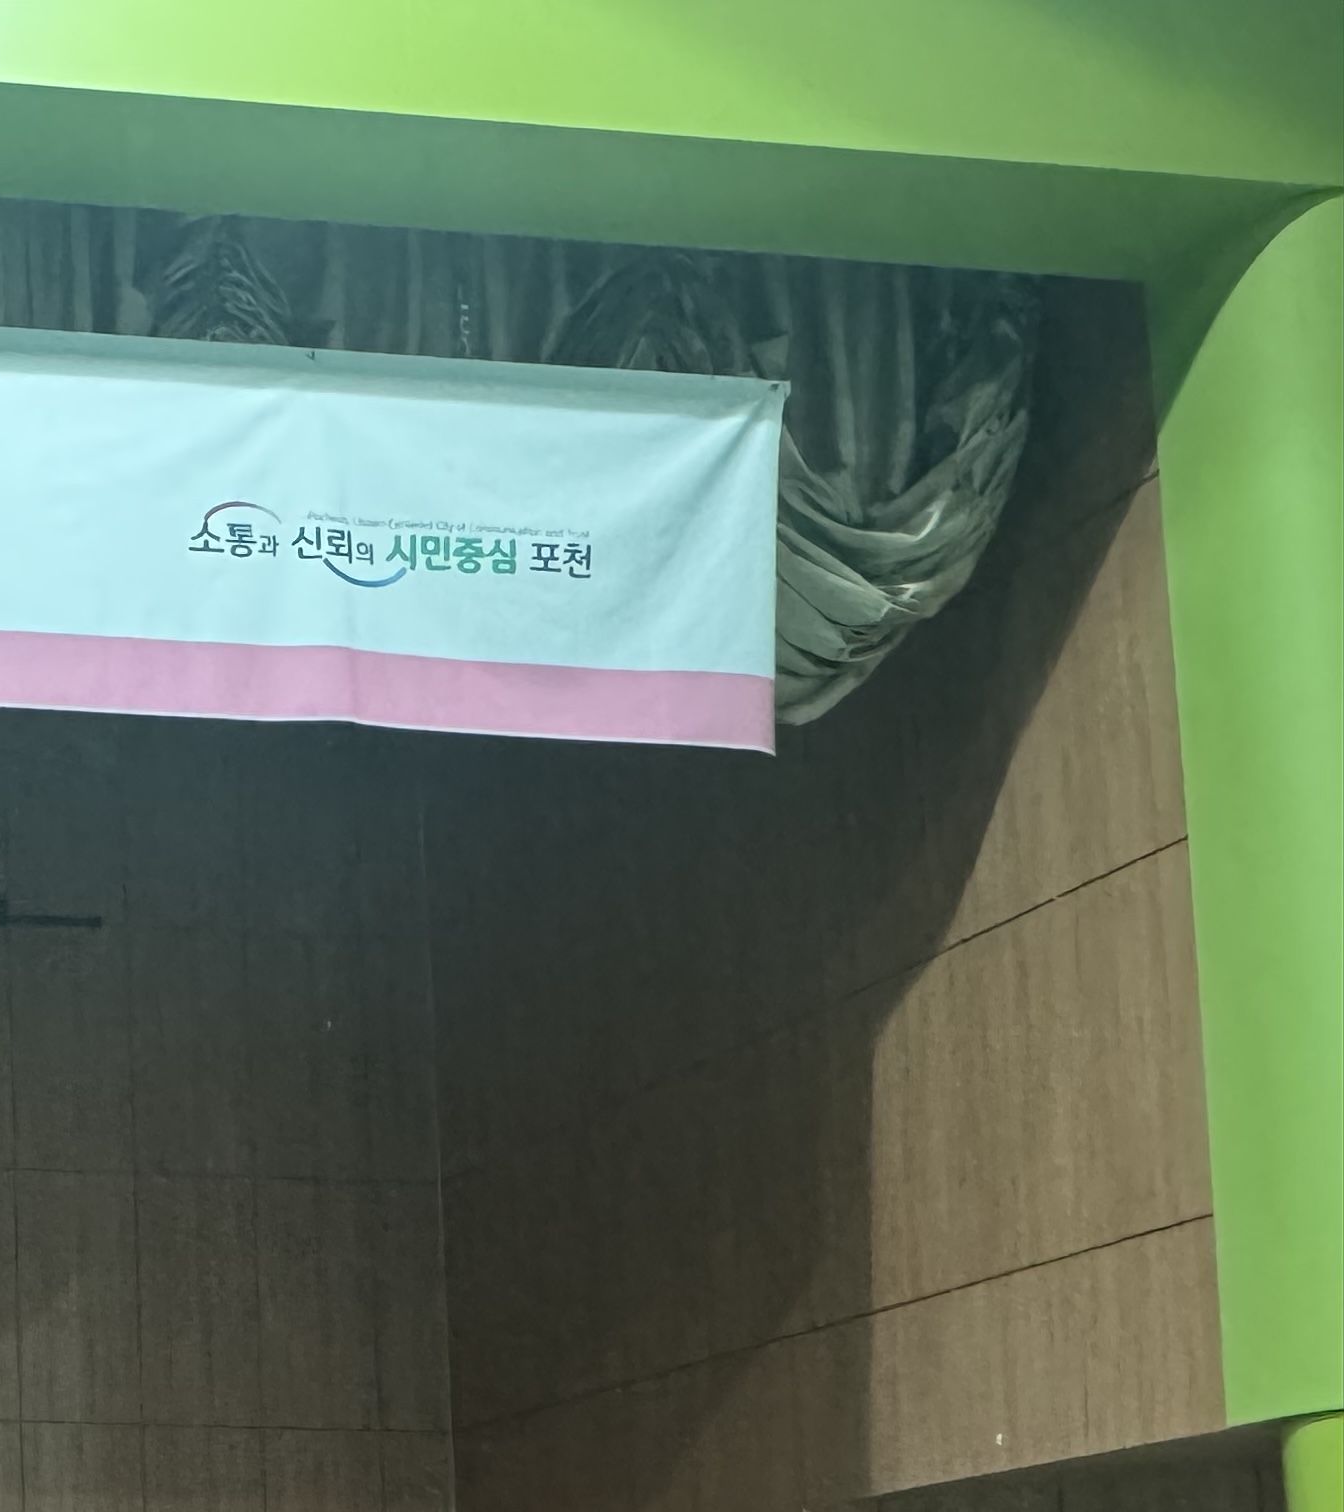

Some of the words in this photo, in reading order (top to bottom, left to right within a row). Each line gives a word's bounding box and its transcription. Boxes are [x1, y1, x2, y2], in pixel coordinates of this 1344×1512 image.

[188, 520, 280, 558] 소통과
[291, 524, 376, 566] 신뢰의
[385, 533, 518, 575] 시민중심
[529, 541, 592, 578] 포천
